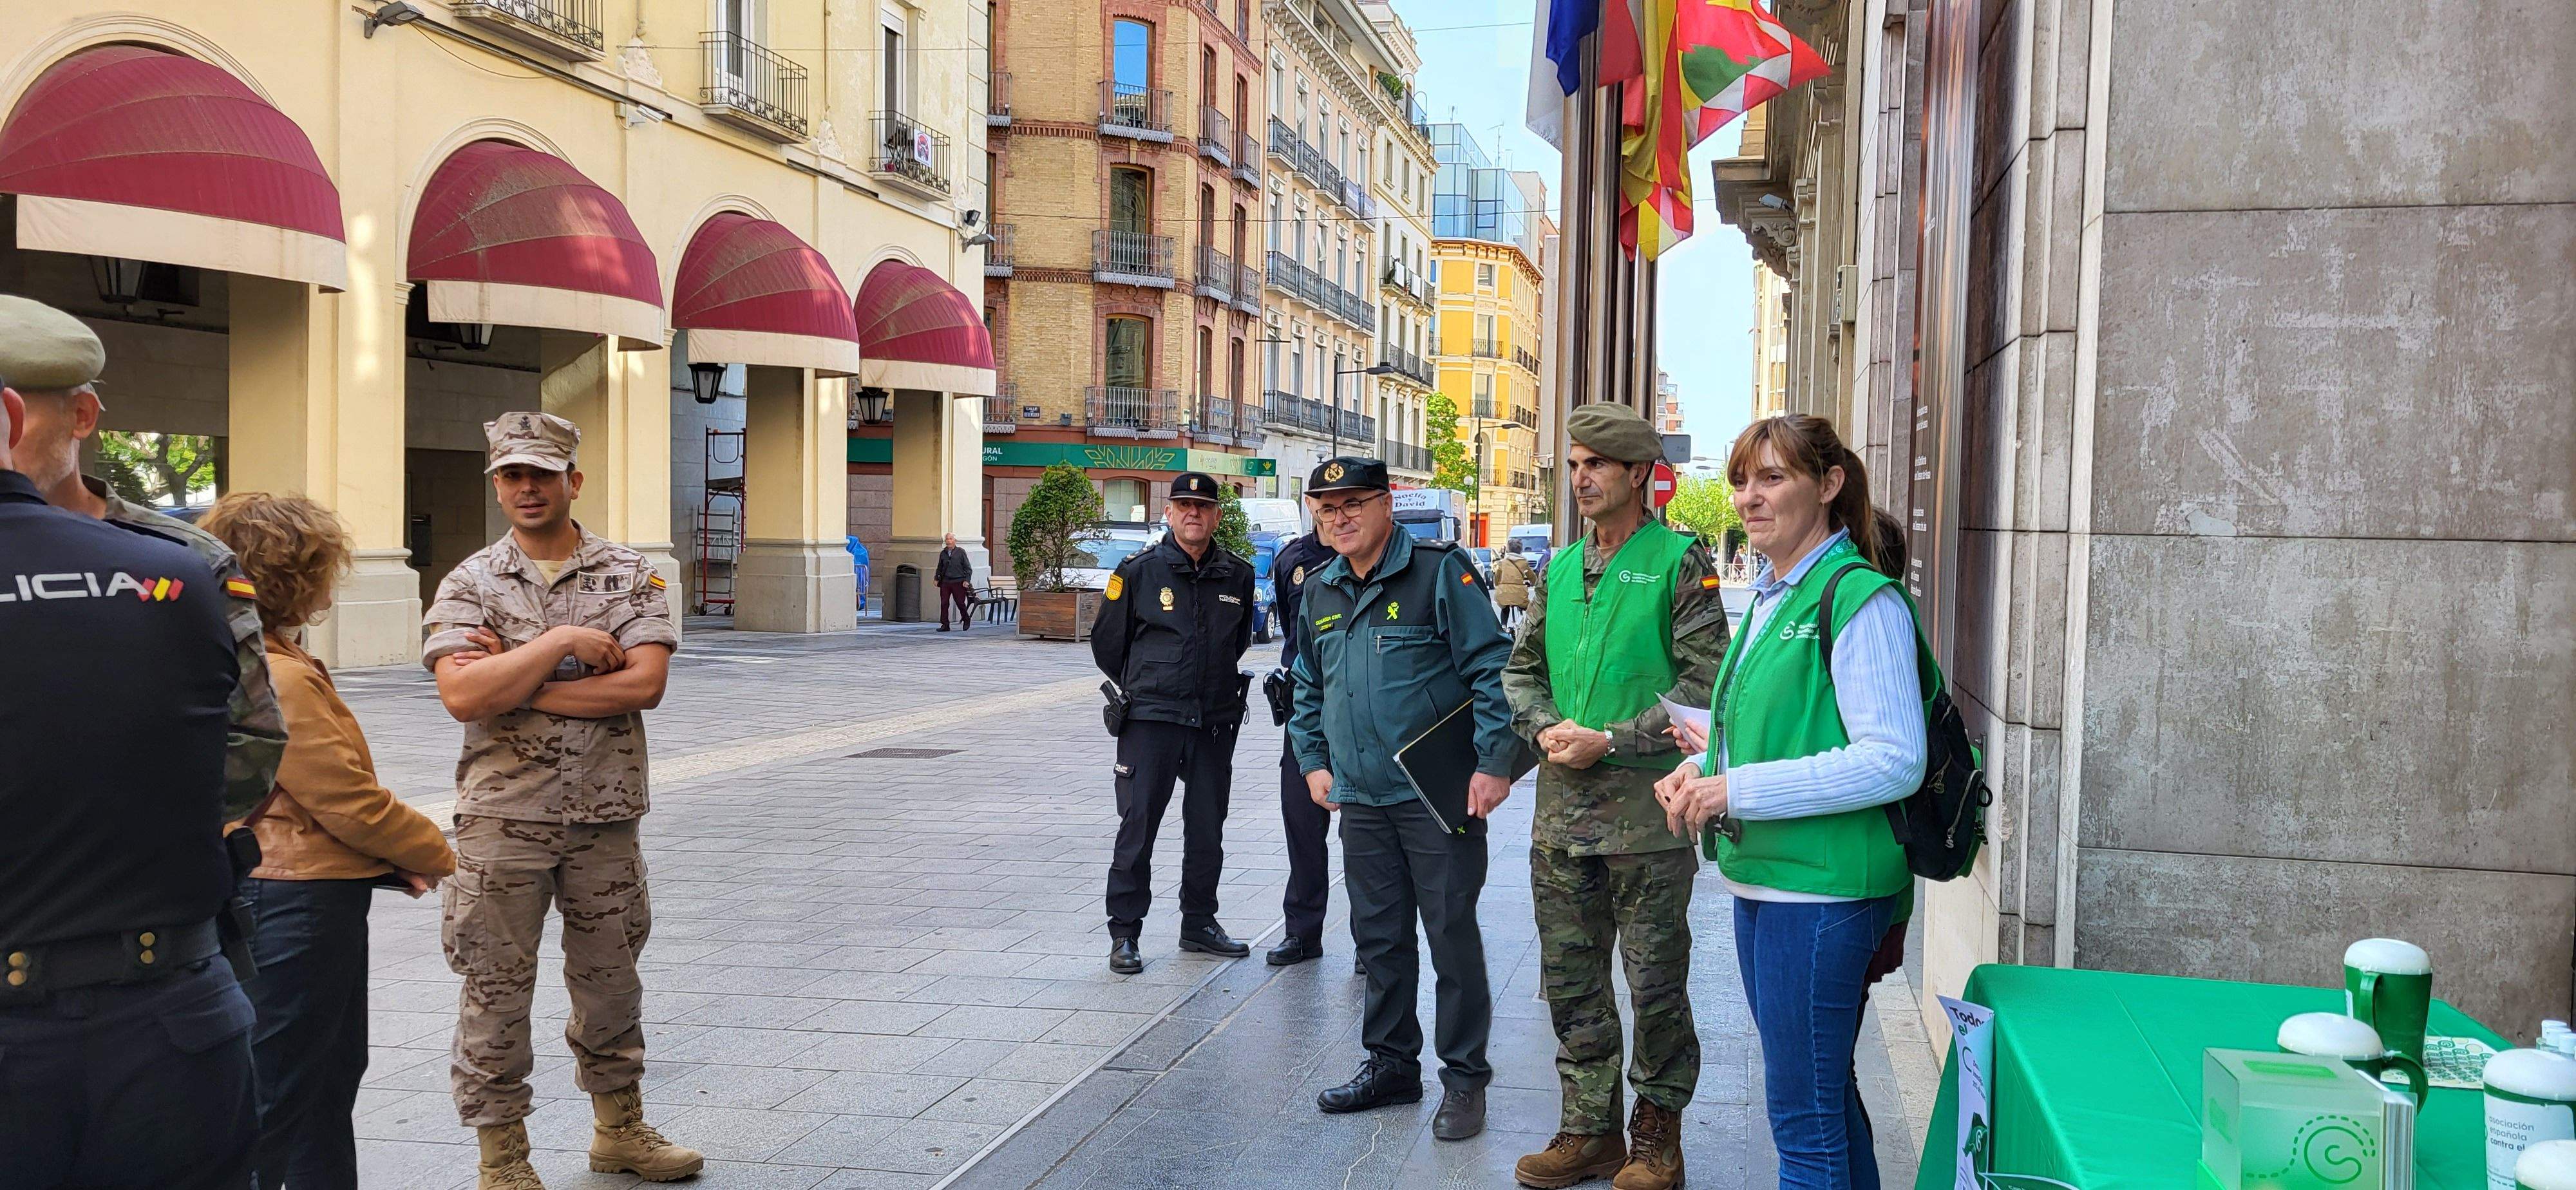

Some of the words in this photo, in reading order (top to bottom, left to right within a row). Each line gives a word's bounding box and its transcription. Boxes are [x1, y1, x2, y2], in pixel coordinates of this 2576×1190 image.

[1948, 1006, 1984, 1027] Todo
[2489, 1116, 2535, 1131] asociación
[2490, 1127, 2527, 1141] española
[2490, 1137, 2514, 1150] contra
